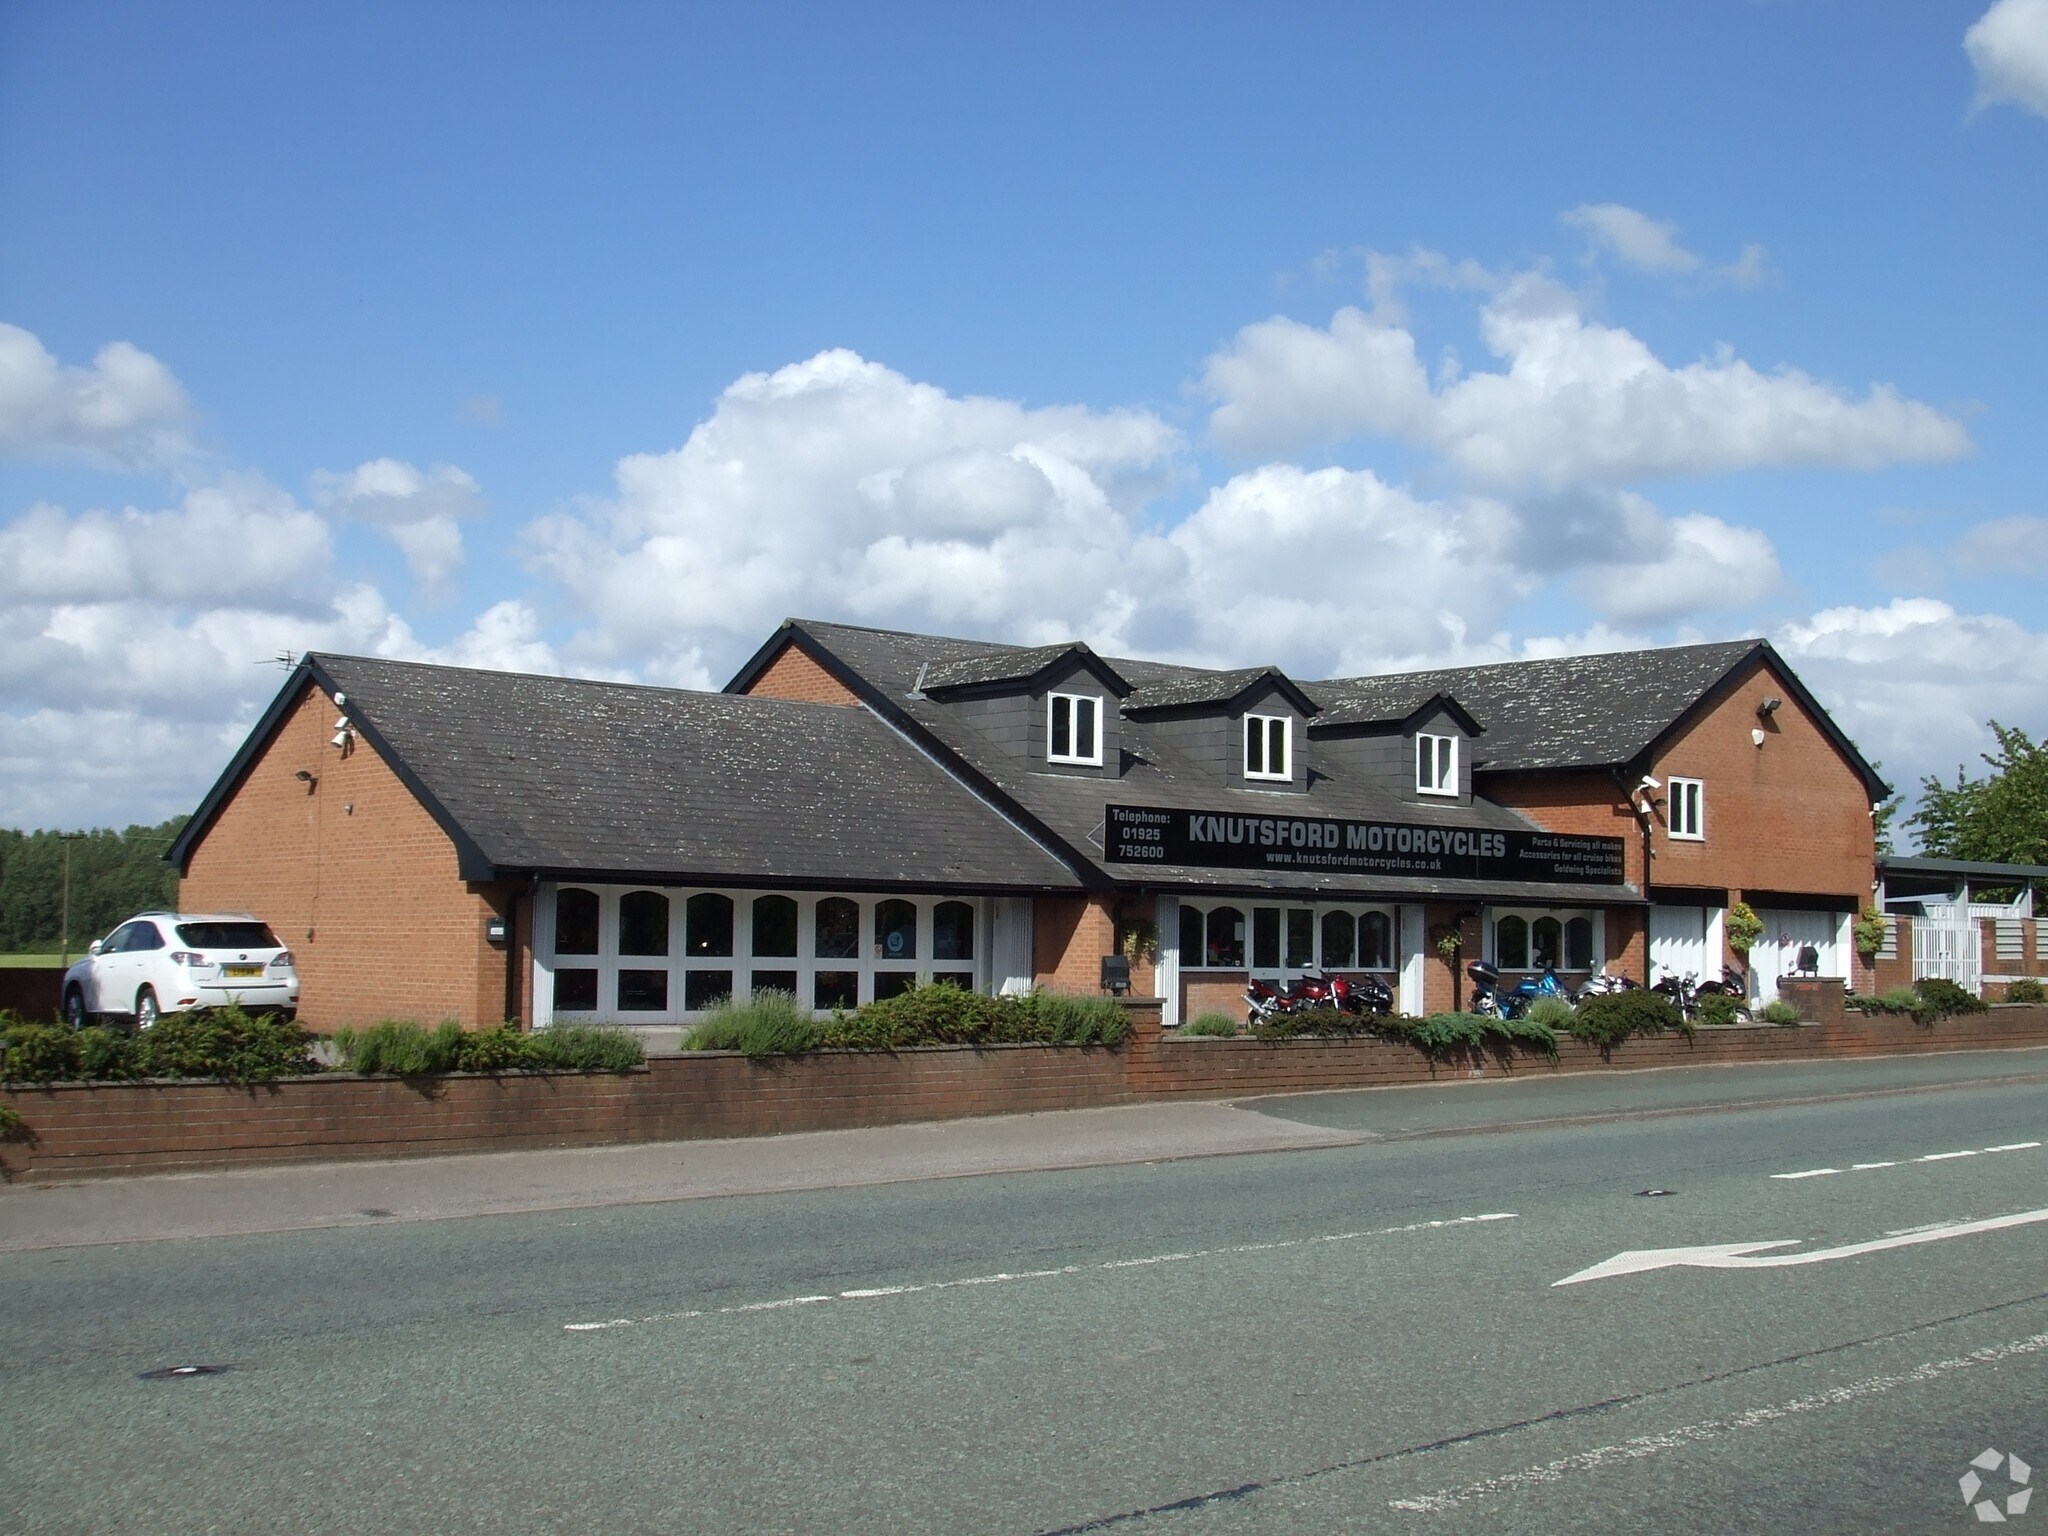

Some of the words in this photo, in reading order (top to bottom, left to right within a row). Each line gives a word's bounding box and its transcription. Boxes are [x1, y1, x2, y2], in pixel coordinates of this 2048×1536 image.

[1112, 809, 1171, 824] Telephone:
[1122, 827, 1161, 841] 01925
[1189, 815, 1339, 849] KNUTSFORD
[1346, 825, 1506, 858] MOTORCYCLES
[1532, 837, 1552, 847] Parts
[1559, 838, 1591, 850] Servicing
[1592, 841, 1600, 849] all
[1601, 842, 1622, 850] makes
[1118, 844, 1164, 858] 752600
[1519, 848, 1560, 860] Accessories
[1562, 851, 1572, 860] for
[1573, 852, 1582, 861] all
[1582, 854, 1604, 862] cruise
[1604, 854, 1622, 863] bikes
[1266, 852, 1442, 870] www.knutsfordmotorcycles.co.uk
[1554, 863, 1584, 876] Goldwing
[1585, 865, 1622, 876] Specialists
